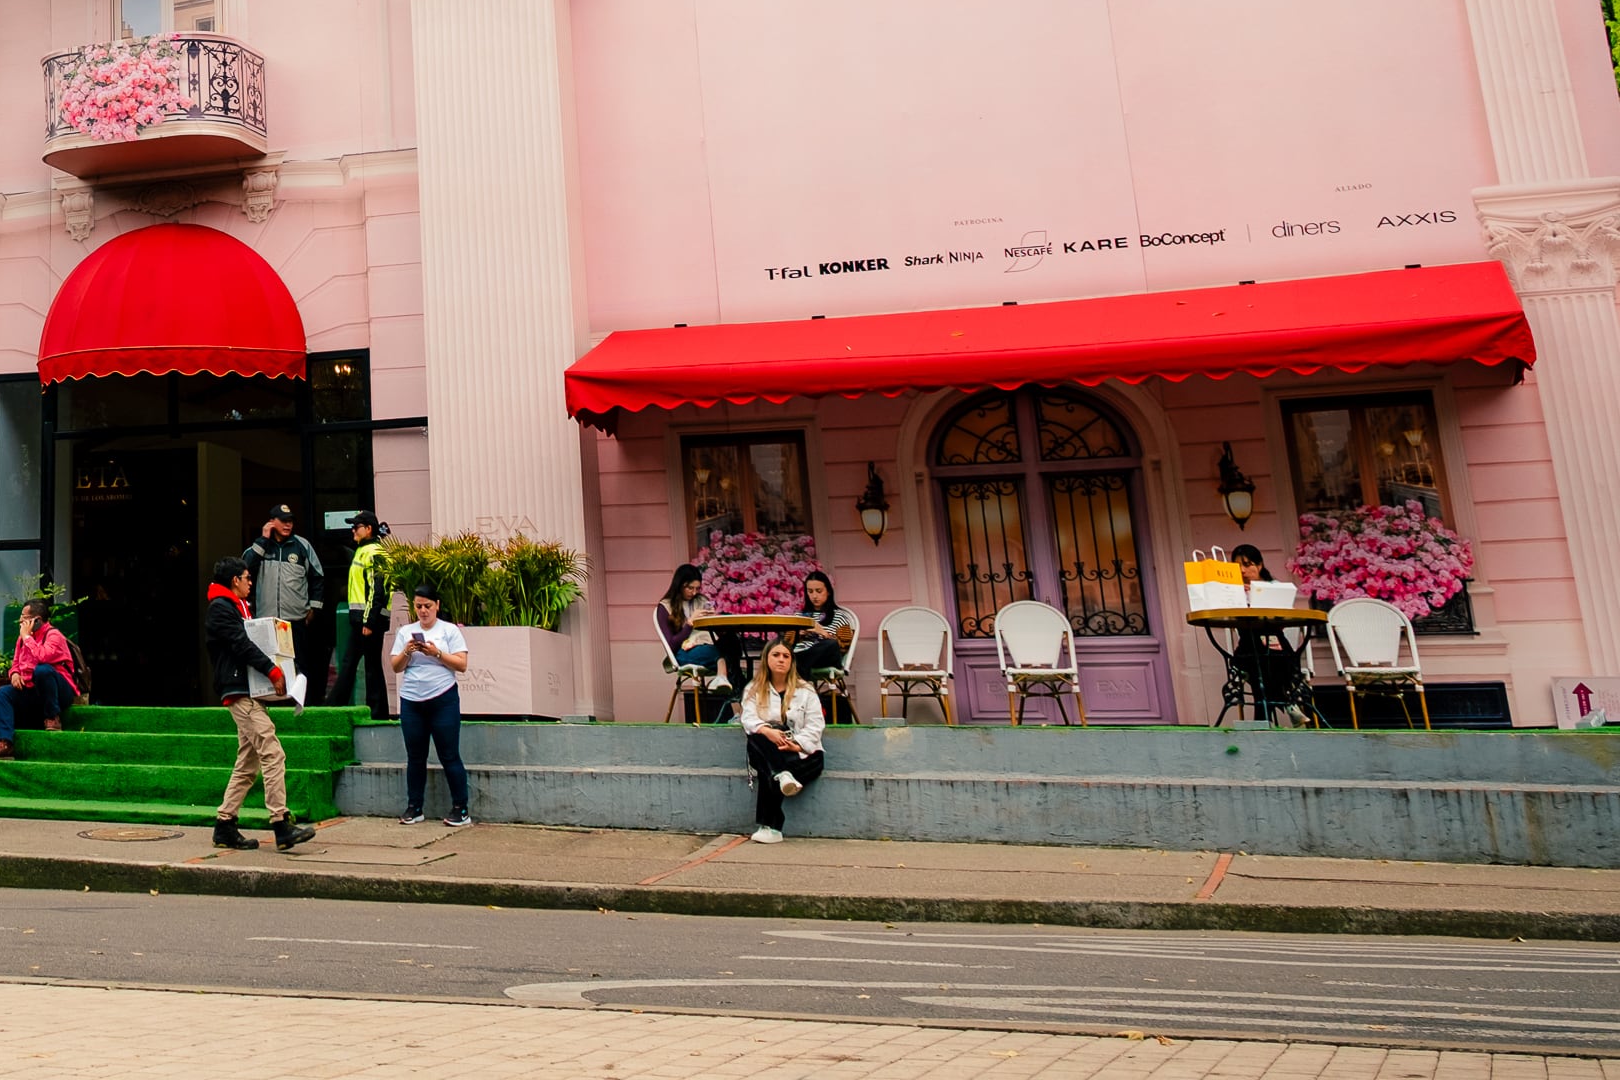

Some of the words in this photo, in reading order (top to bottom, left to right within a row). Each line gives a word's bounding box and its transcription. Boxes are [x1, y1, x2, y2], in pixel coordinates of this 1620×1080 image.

[1335, 183, 1372, 192] ALIADO
[1377, 210, 1457, 228] AXXIS
[1140, 229, 1225, 247] BoConcept
[1272, 221, 1341, 238] diners
[1004, 242, 1053, 258] NESCAFÉ
[1063, 237, 1128, 253] KARE
[819, 258, 890, 275] KONKER
[904, 254, 944, 266] Shark
[949, 251, 984, 263] NINJA
[476, 515, 538, 535] EVA
